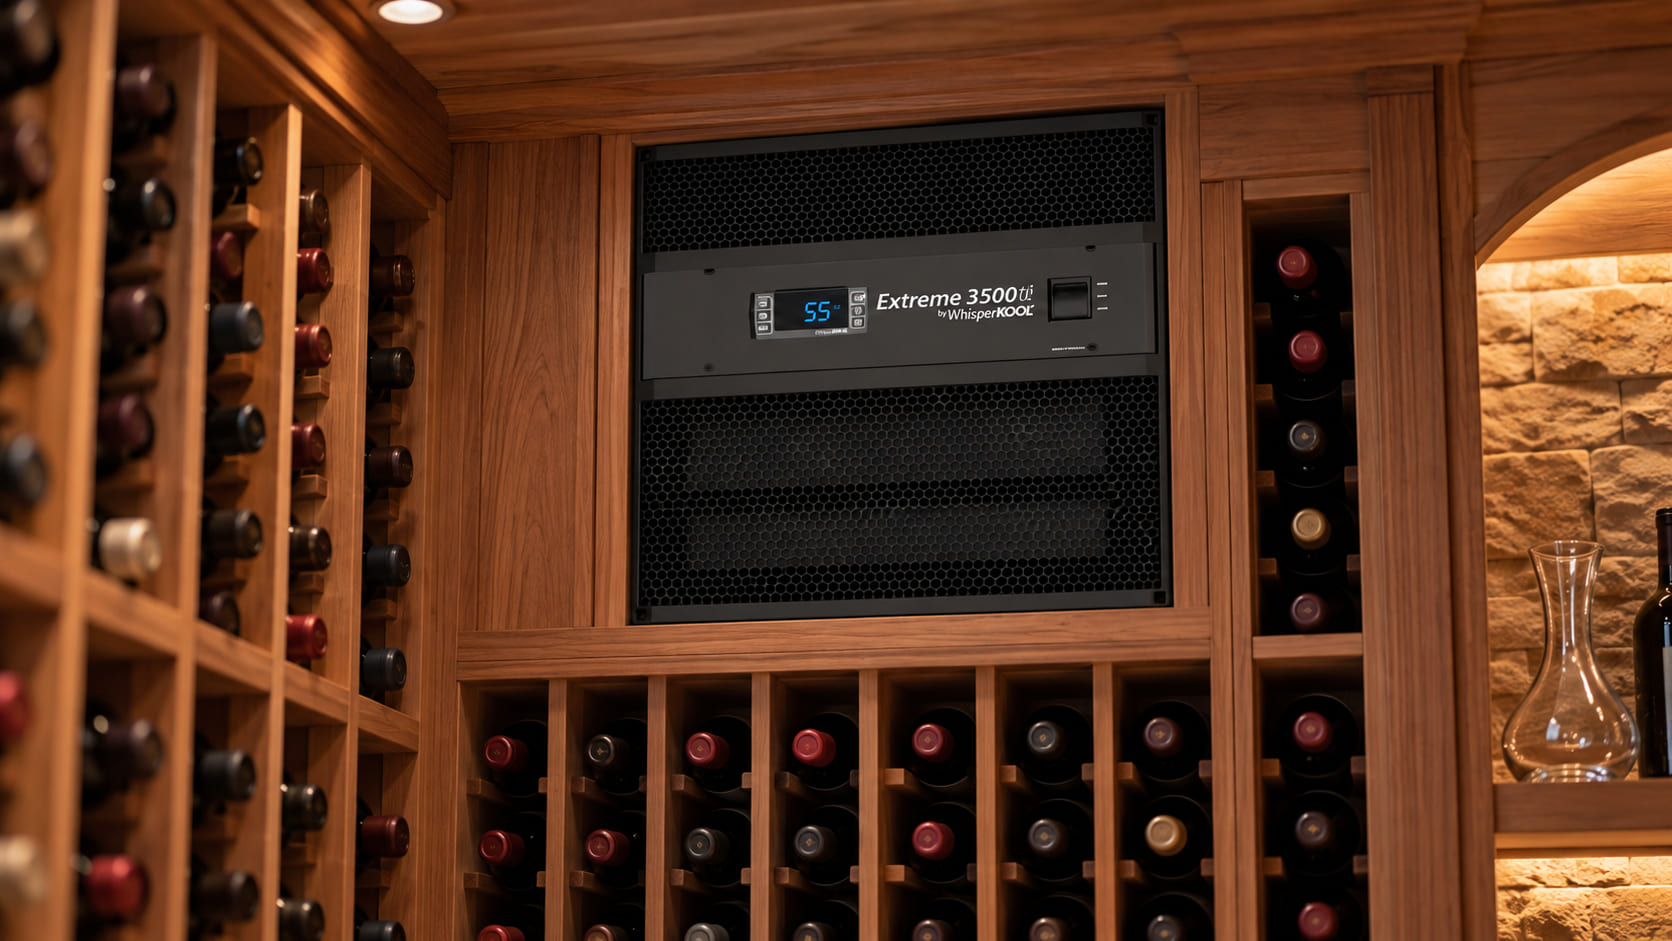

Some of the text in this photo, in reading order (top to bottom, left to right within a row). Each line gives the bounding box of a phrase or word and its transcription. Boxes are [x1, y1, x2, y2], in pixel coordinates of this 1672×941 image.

[876, 293, 962, 311] Extreme
[804, 301, 831, 322] 55
[938, 305, 1034, 323] by WhisperKOOL
